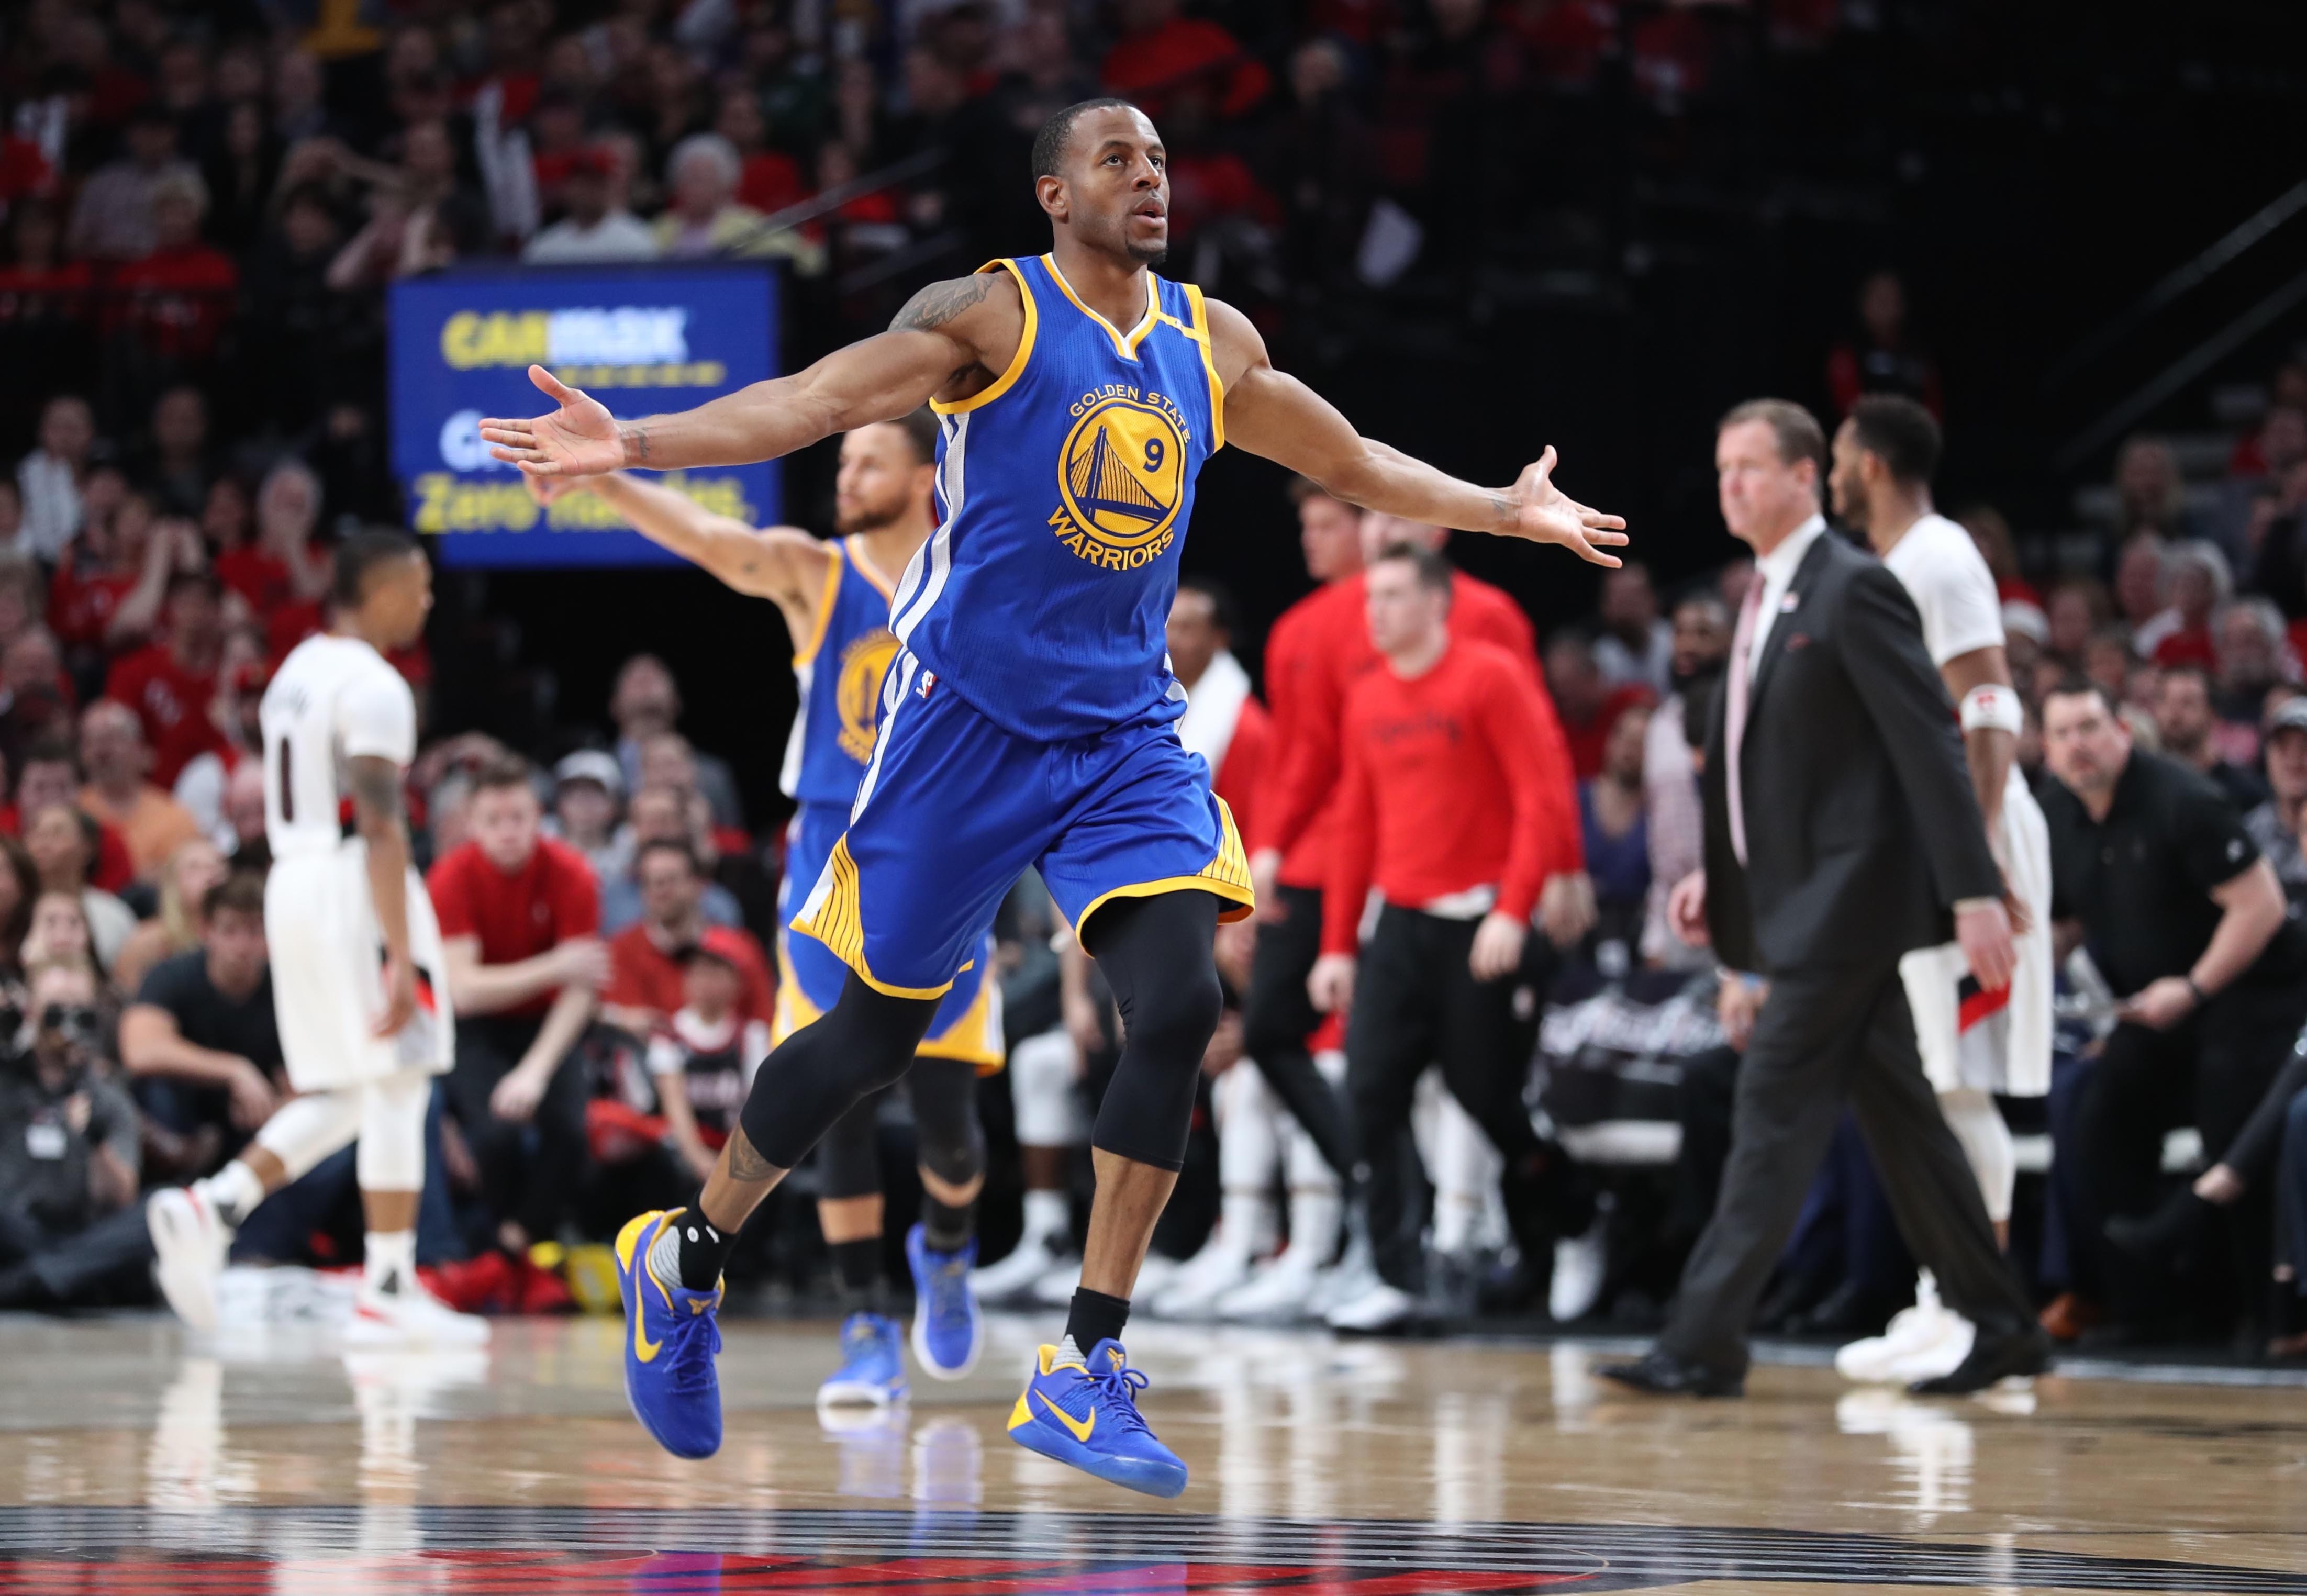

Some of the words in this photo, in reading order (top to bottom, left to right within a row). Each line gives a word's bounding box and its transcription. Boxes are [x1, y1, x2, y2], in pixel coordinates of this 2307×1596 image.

[1069, 384, 1140, 418] GOLDEN
[1146, 392, 1191, 444] STATE
[1143, 438, 1164, 473] 9
[1047, 505, 1174, 572] WARRIORS
